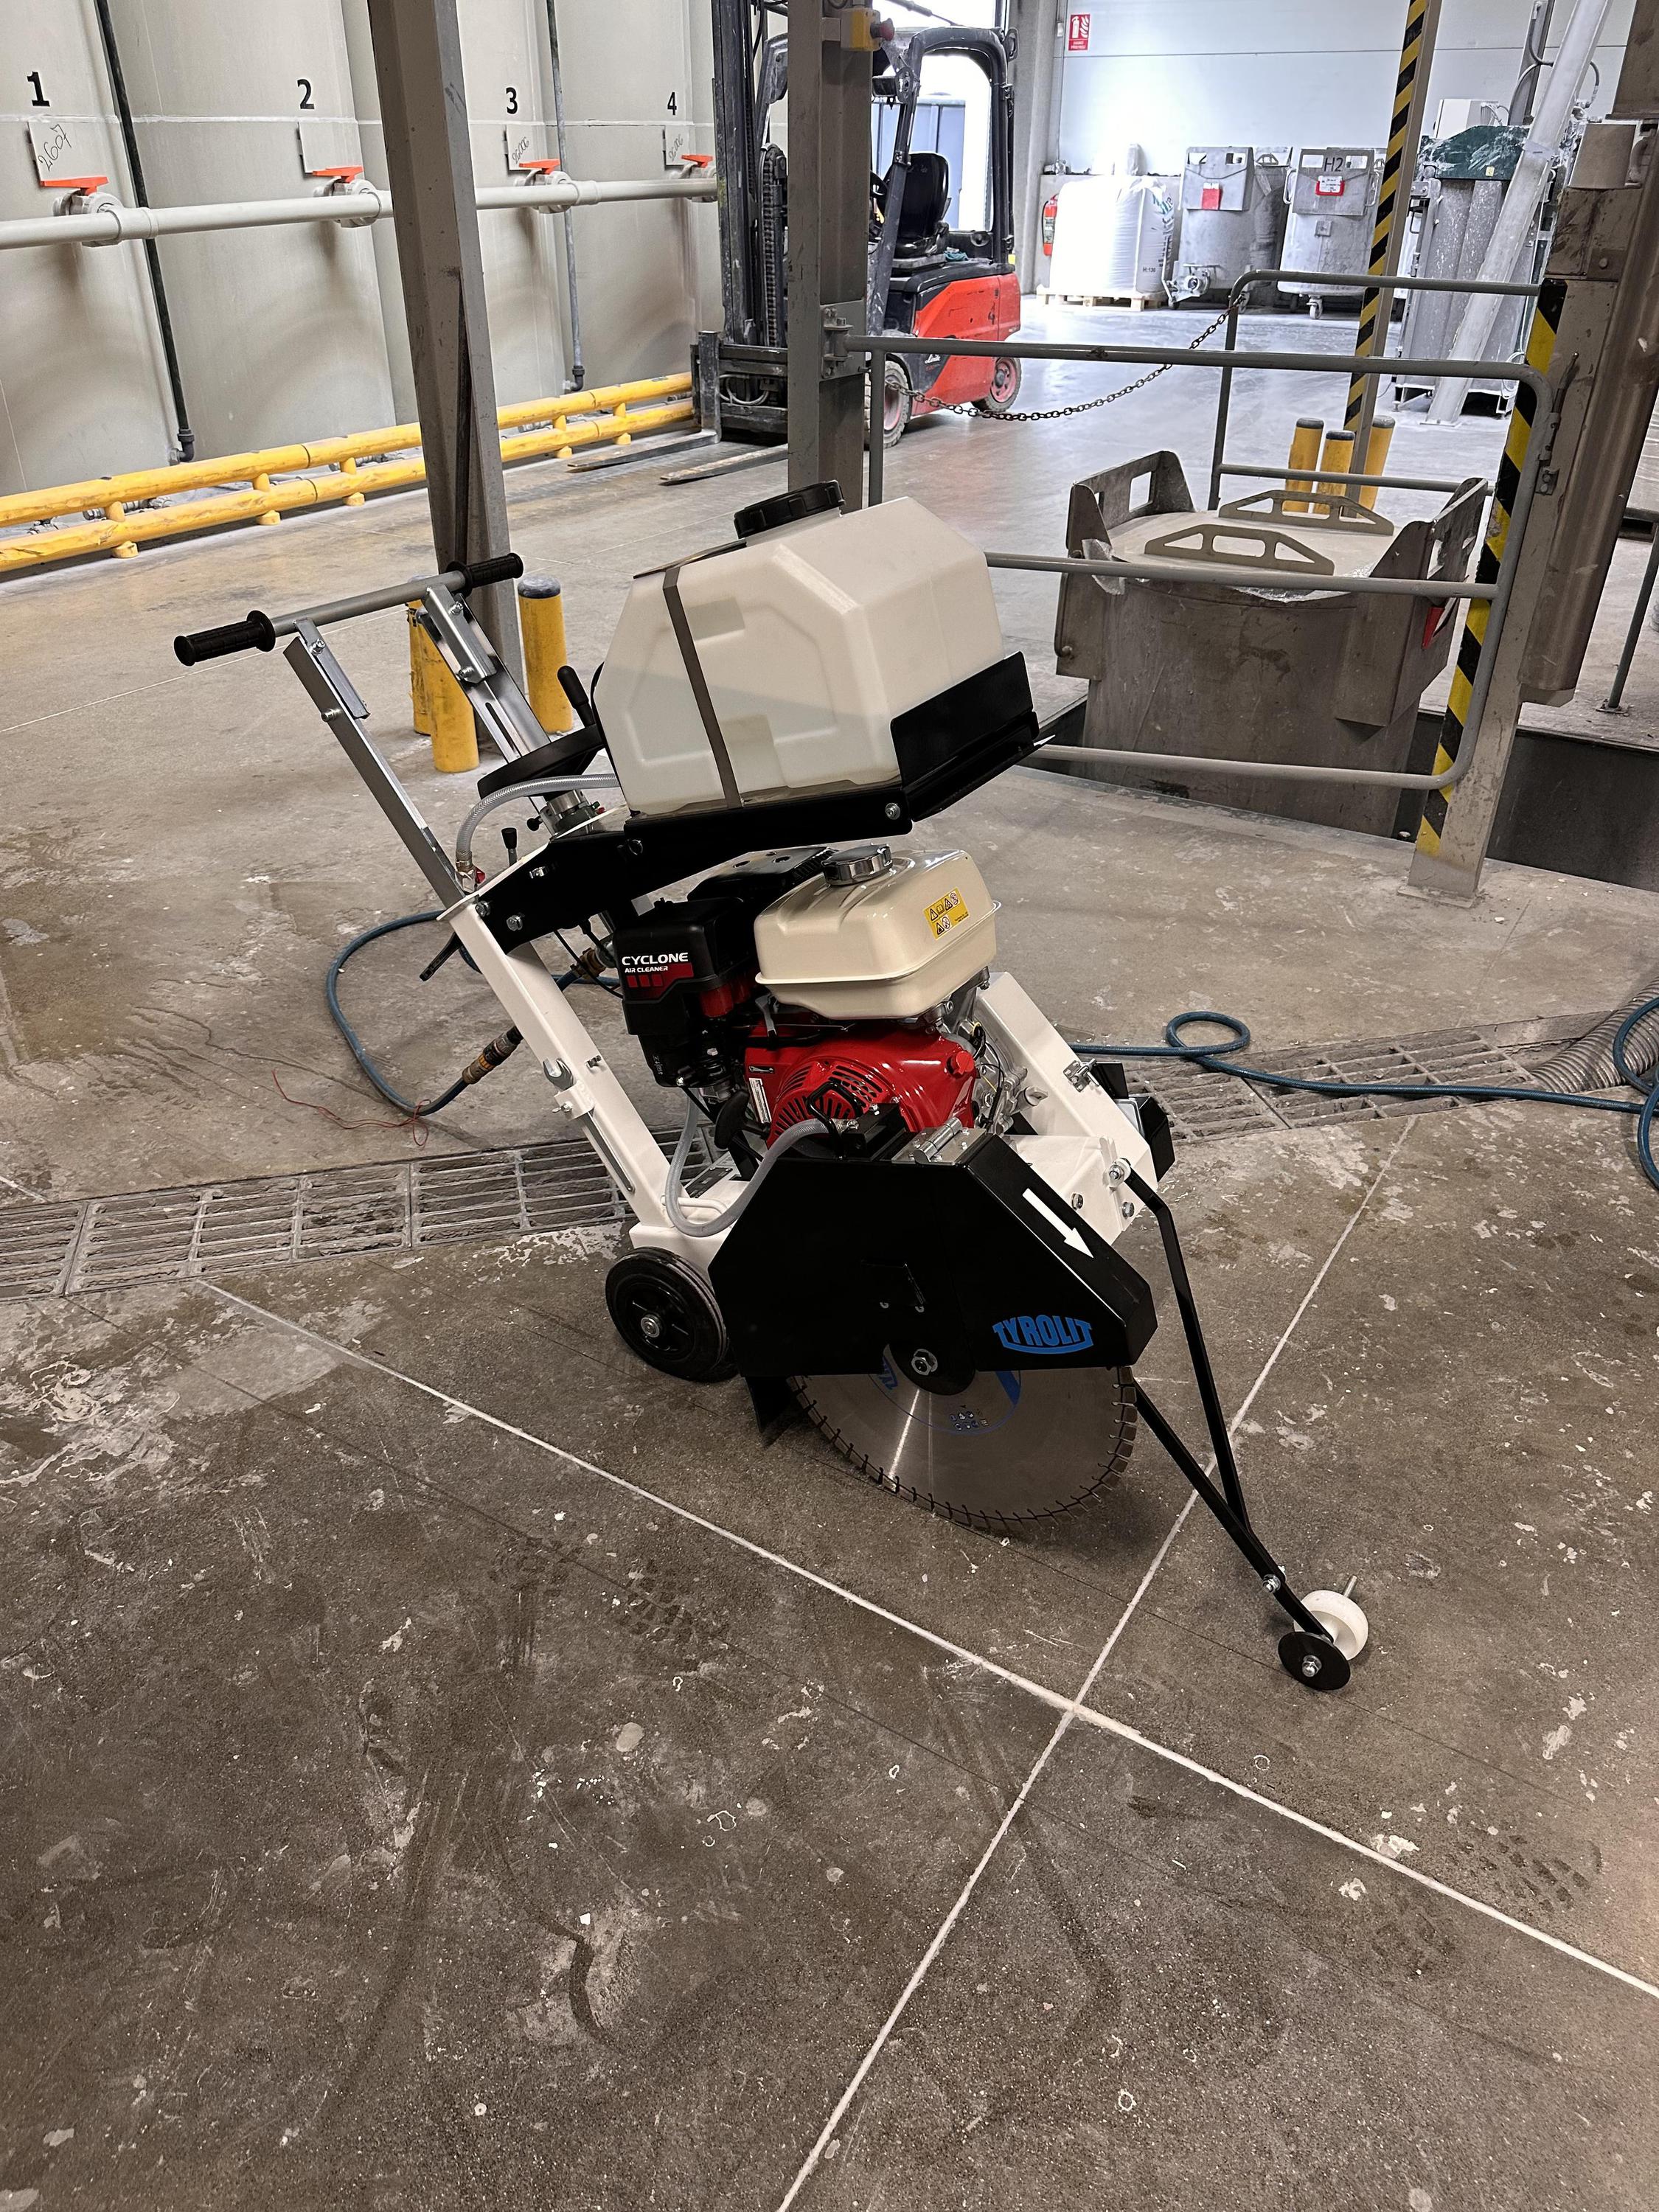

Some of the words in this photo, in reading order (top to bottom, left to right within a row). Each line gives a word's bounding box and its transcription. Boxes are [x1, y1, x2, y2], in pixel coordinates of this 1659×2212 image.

[27, 71, 50, 107] 1
[297, 78, 315, 110] 2
[506, 86, 518, 115] 3
[667, 91, 678, 116] 4
[38, 124, 72, 171] 2607
[1324, 157, 1343, 172] H2
[622, 952, 689, 966] CYCLONE
[992, 1315, 1094, 1354] TYROLIT
